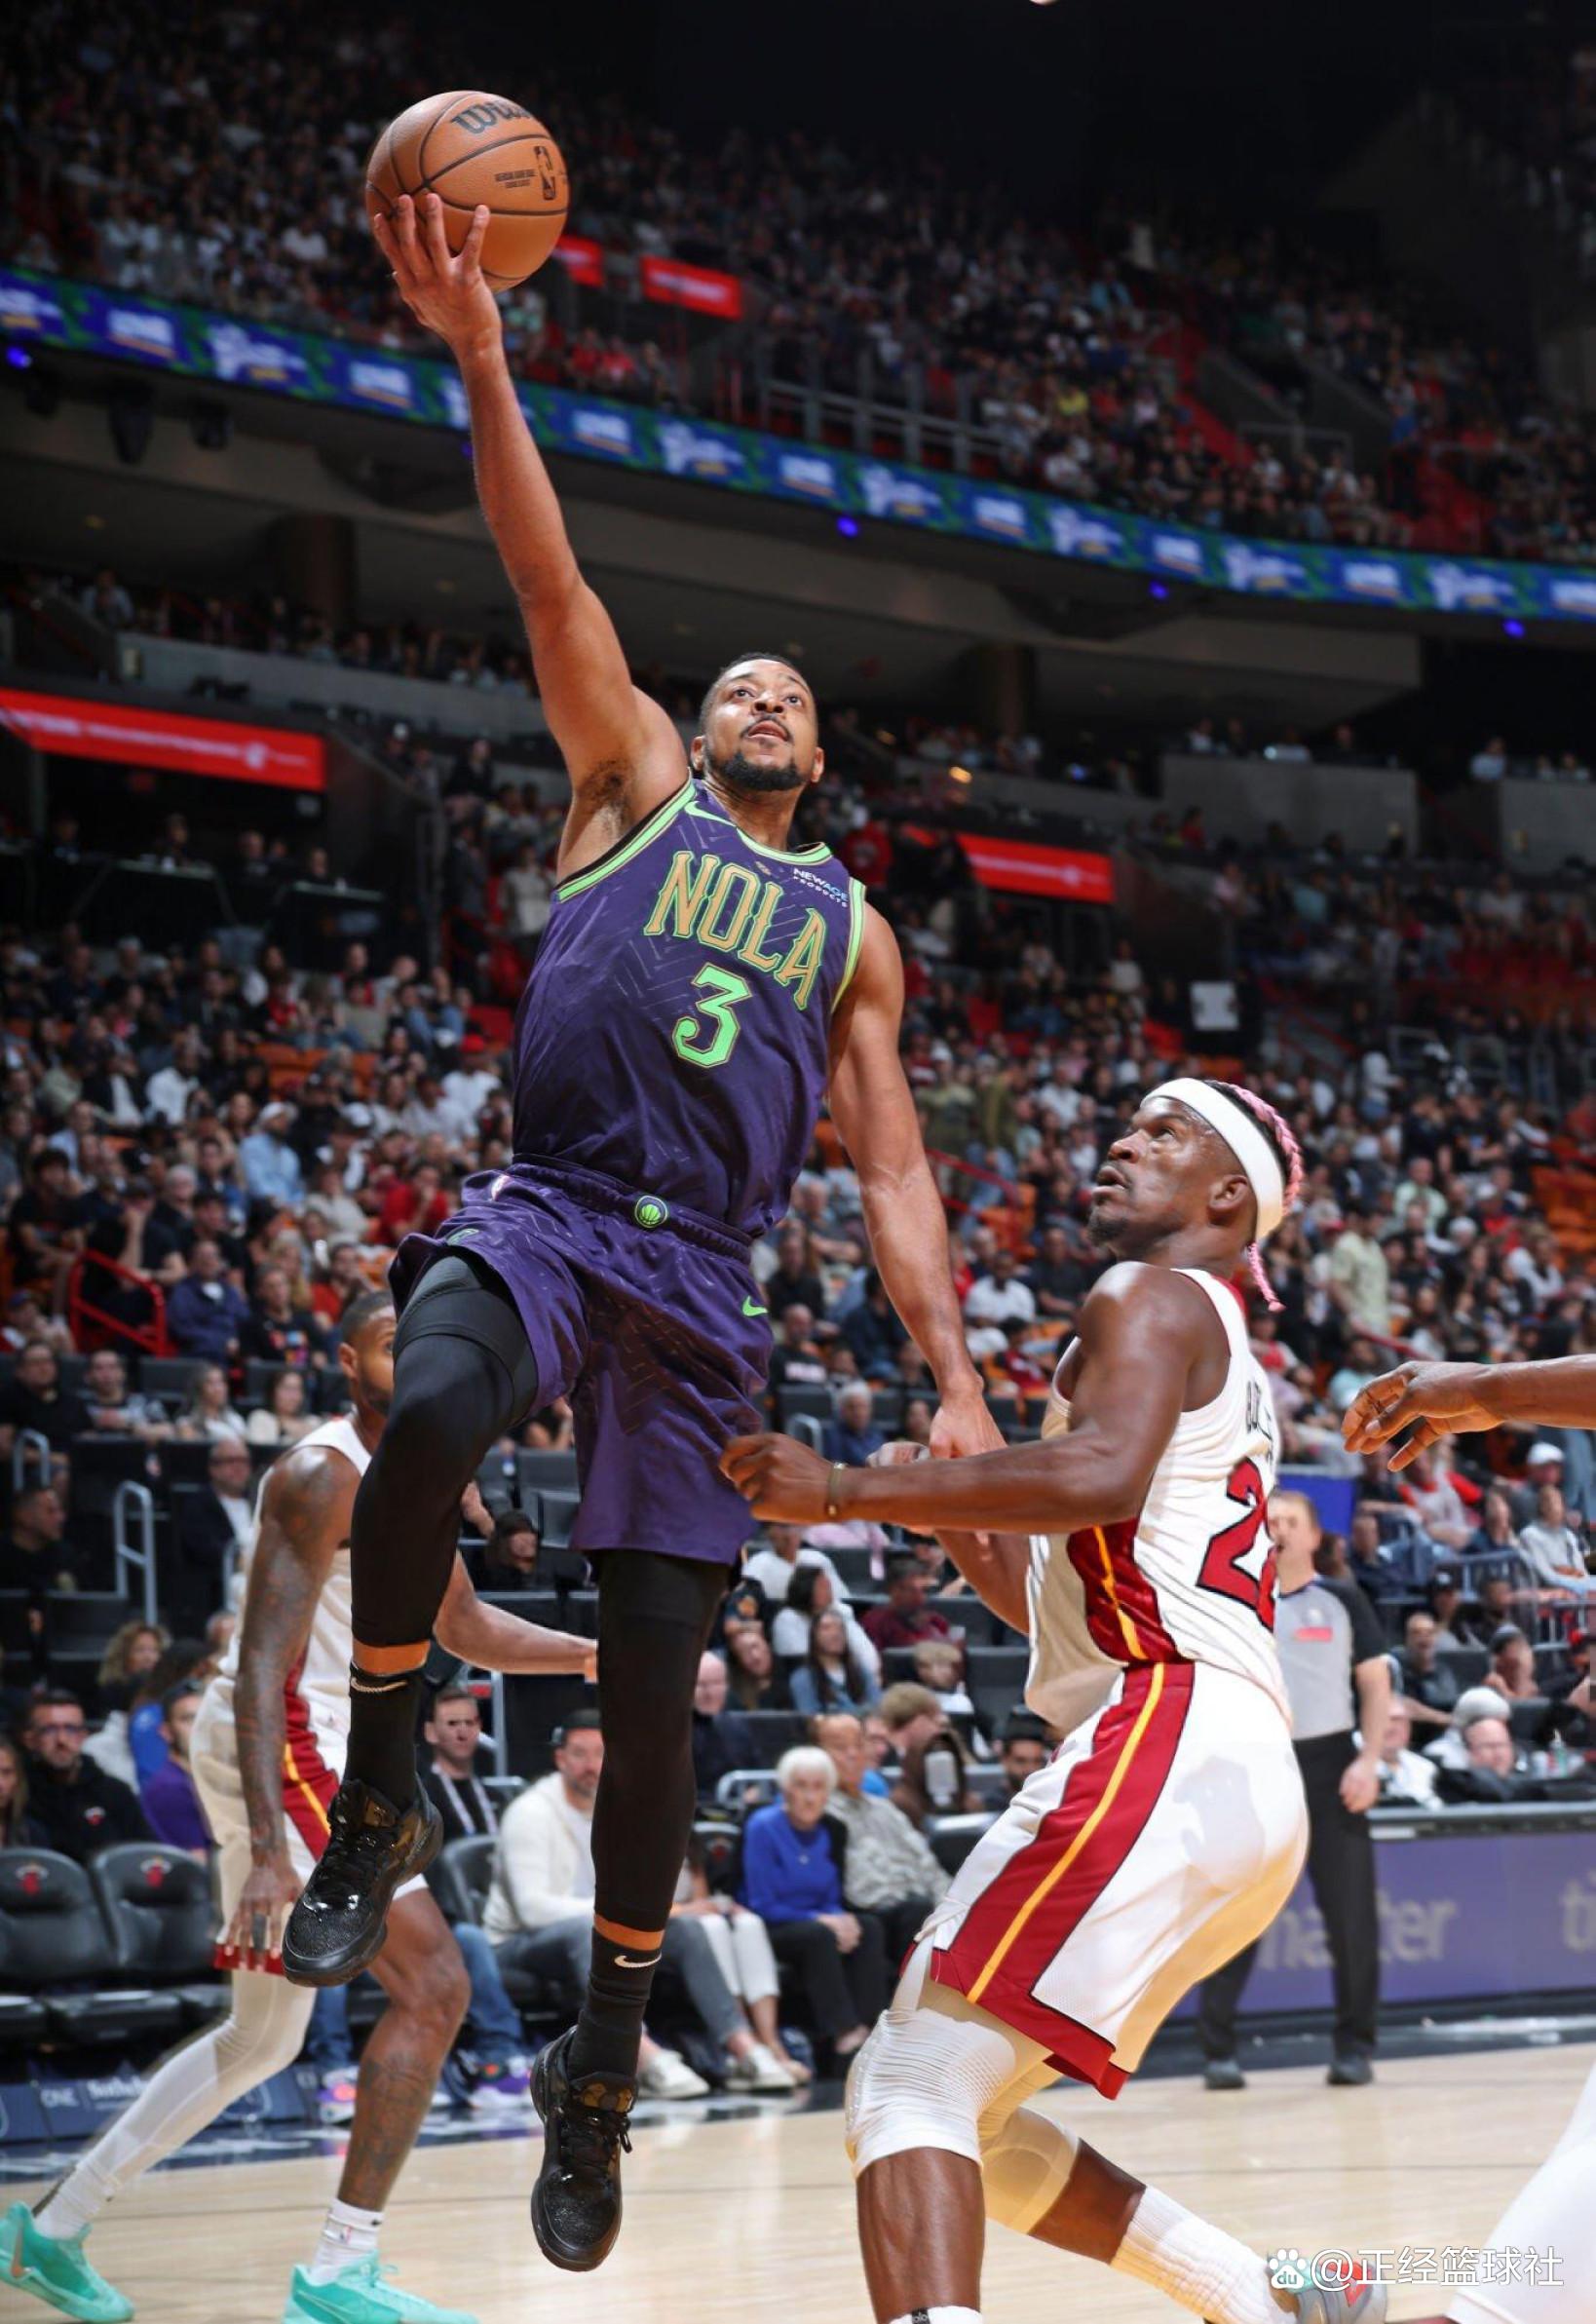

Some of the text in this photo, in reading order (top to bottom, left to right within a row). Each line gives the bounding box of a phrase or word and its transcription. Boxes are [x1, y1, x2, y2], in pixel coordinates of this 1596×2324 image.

[643, 851, 826, 1010] NOLA
[793, 867, 848, 902] NEWAGE
[672, 963, 752, 1067] 3
[1196, 1457, 1275, 1633] 2
